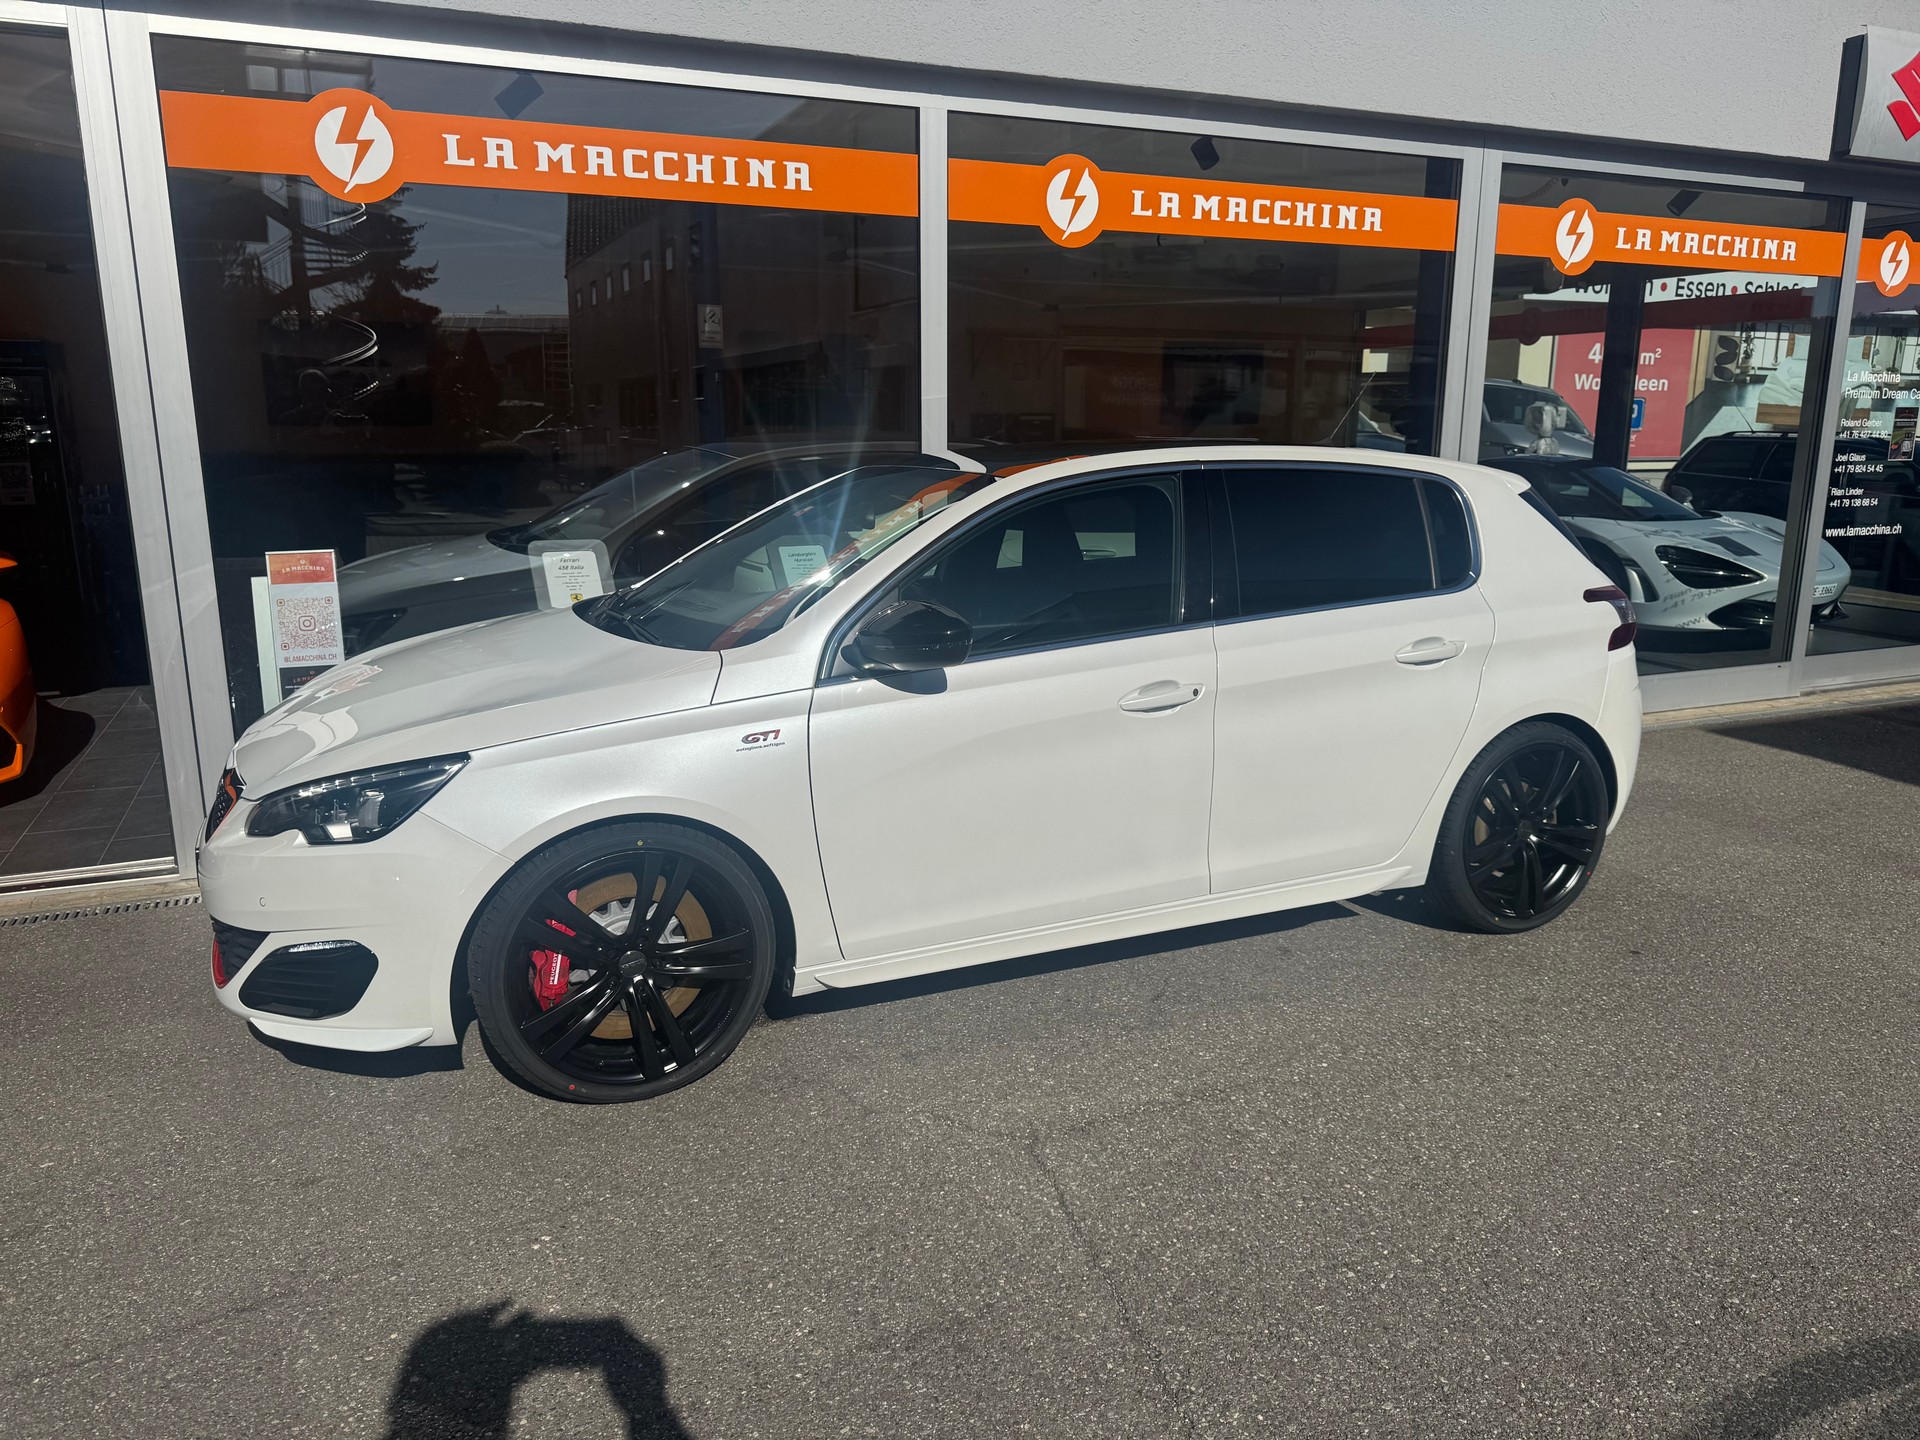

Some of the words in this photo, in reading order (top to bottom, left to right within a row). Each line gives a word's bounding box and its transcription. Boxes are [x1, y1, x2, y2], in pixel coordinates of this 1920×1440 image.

[441, 133, 518, 170] LA
[533, 140, 813, 191] MACCHINA
[1131, 189, 1181, 219] LA
[1192, 194, 1383, 232] MACCHINA
[1615, 227, 1652, 251] LA
[1658, 230, 1797, 261] MACCHINA
[1675, 277, 1726, 298] Essen
[1847, 370, 1858, 381] La
[1860, 370, 1901, 383] Macchina
[1844, 387, 1880, 399] Premium
[1882, 387, 1909, 399] Dream
[1840, 418, 1861, 427] Roland
[1862, 419, 1883, 428] Gerber
[1835, 453, 1848, 462] Joel
[1849, 453, 1866, 461] Glaus
[1834, 465, 1845, 473] +41
[1846, 465, 1855, 473] 79
[1855, 465, 1867, 473] 824
[1867, 465, 1875, 473] 54
[1875, 464, 1884, 472] 45
[1831, 487, 1844, 496] Rian
[1845, 488, 1864, 496] Linder
[1829, 499, 1840, 507] +41
[1842, 499, 1850, 507] 79
[1870, 498, 1879, 506] 54
[1825, 523, 1902, 538] www.lamacchina.ch
[741, 729, 781, 744] GTI
[550, 953, 558, 985] PEUGEOT
